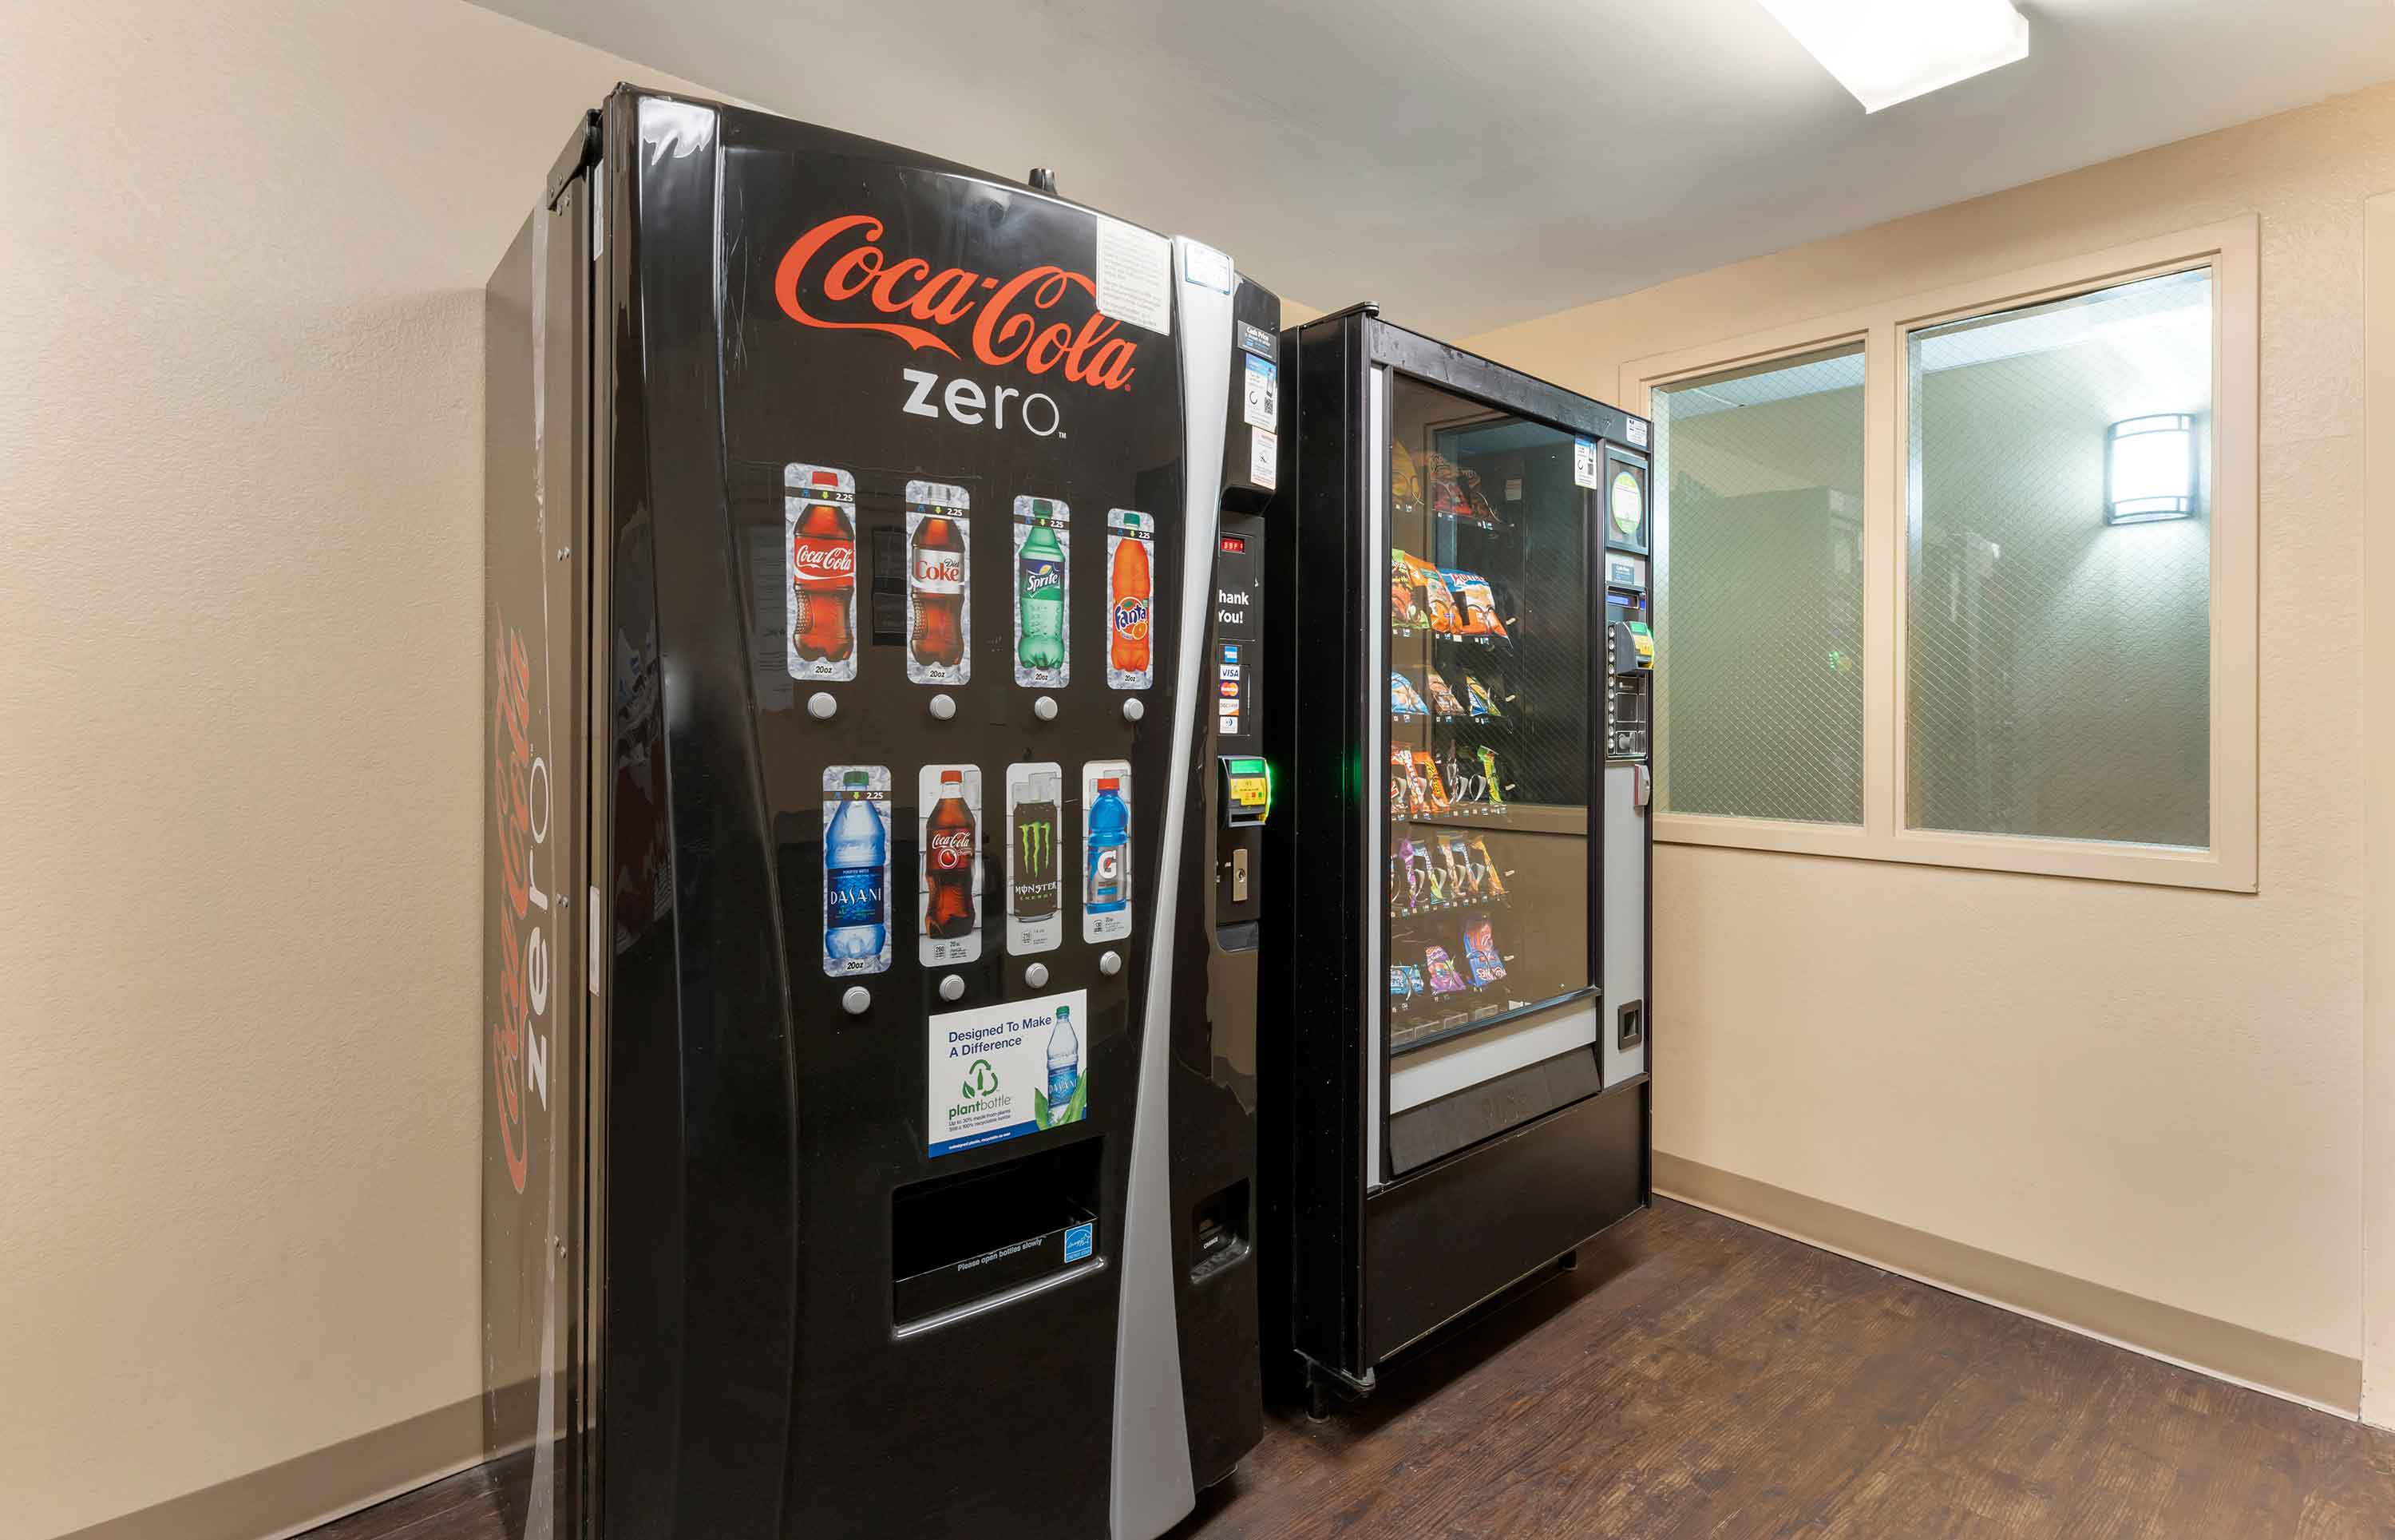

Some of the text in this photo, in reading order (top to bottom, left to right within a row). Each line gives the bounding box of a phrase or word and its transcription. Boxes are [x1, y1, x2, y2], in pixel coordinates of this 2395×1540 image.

[775, 215, 1137, 390] Coca-Cola
[903, 368, 1059, 436] zero
[836, 493, 853, 502] 2.25
[947, 508, 963, 517] 2.25
[797, 544, 853, 571] Coca-Cola
[916, 560, 960, 581] Coke
[1027, 571, 1059, 592] Sprite
[1219, 590, 1249, 605] hank
[1114, 604, 1146, 631] Fanta
[1218, 610, 1244, 624] You!
[1222, 669, 1239, 678] VISA
[932, 832, 971, 849] Coca-Cola
[1098, 850, 1117, 879] G
[830, 887, 881, 905] DASANI
[1015, 881, 1057, 895] MONSTER
[494, 605, 529, 1194] Coca-Cola
[528, 757, 548, 1111] zero
[847, 961, 864, 970] 20oz
[948, 1016, 1051, 1043] Designed To Make
[949, 1037, 1022, 1058] A Difference
[949, 1095, 1011, 1120] plantbottle
[958, 1238, 1043, 1271] Please open bottles slowly
